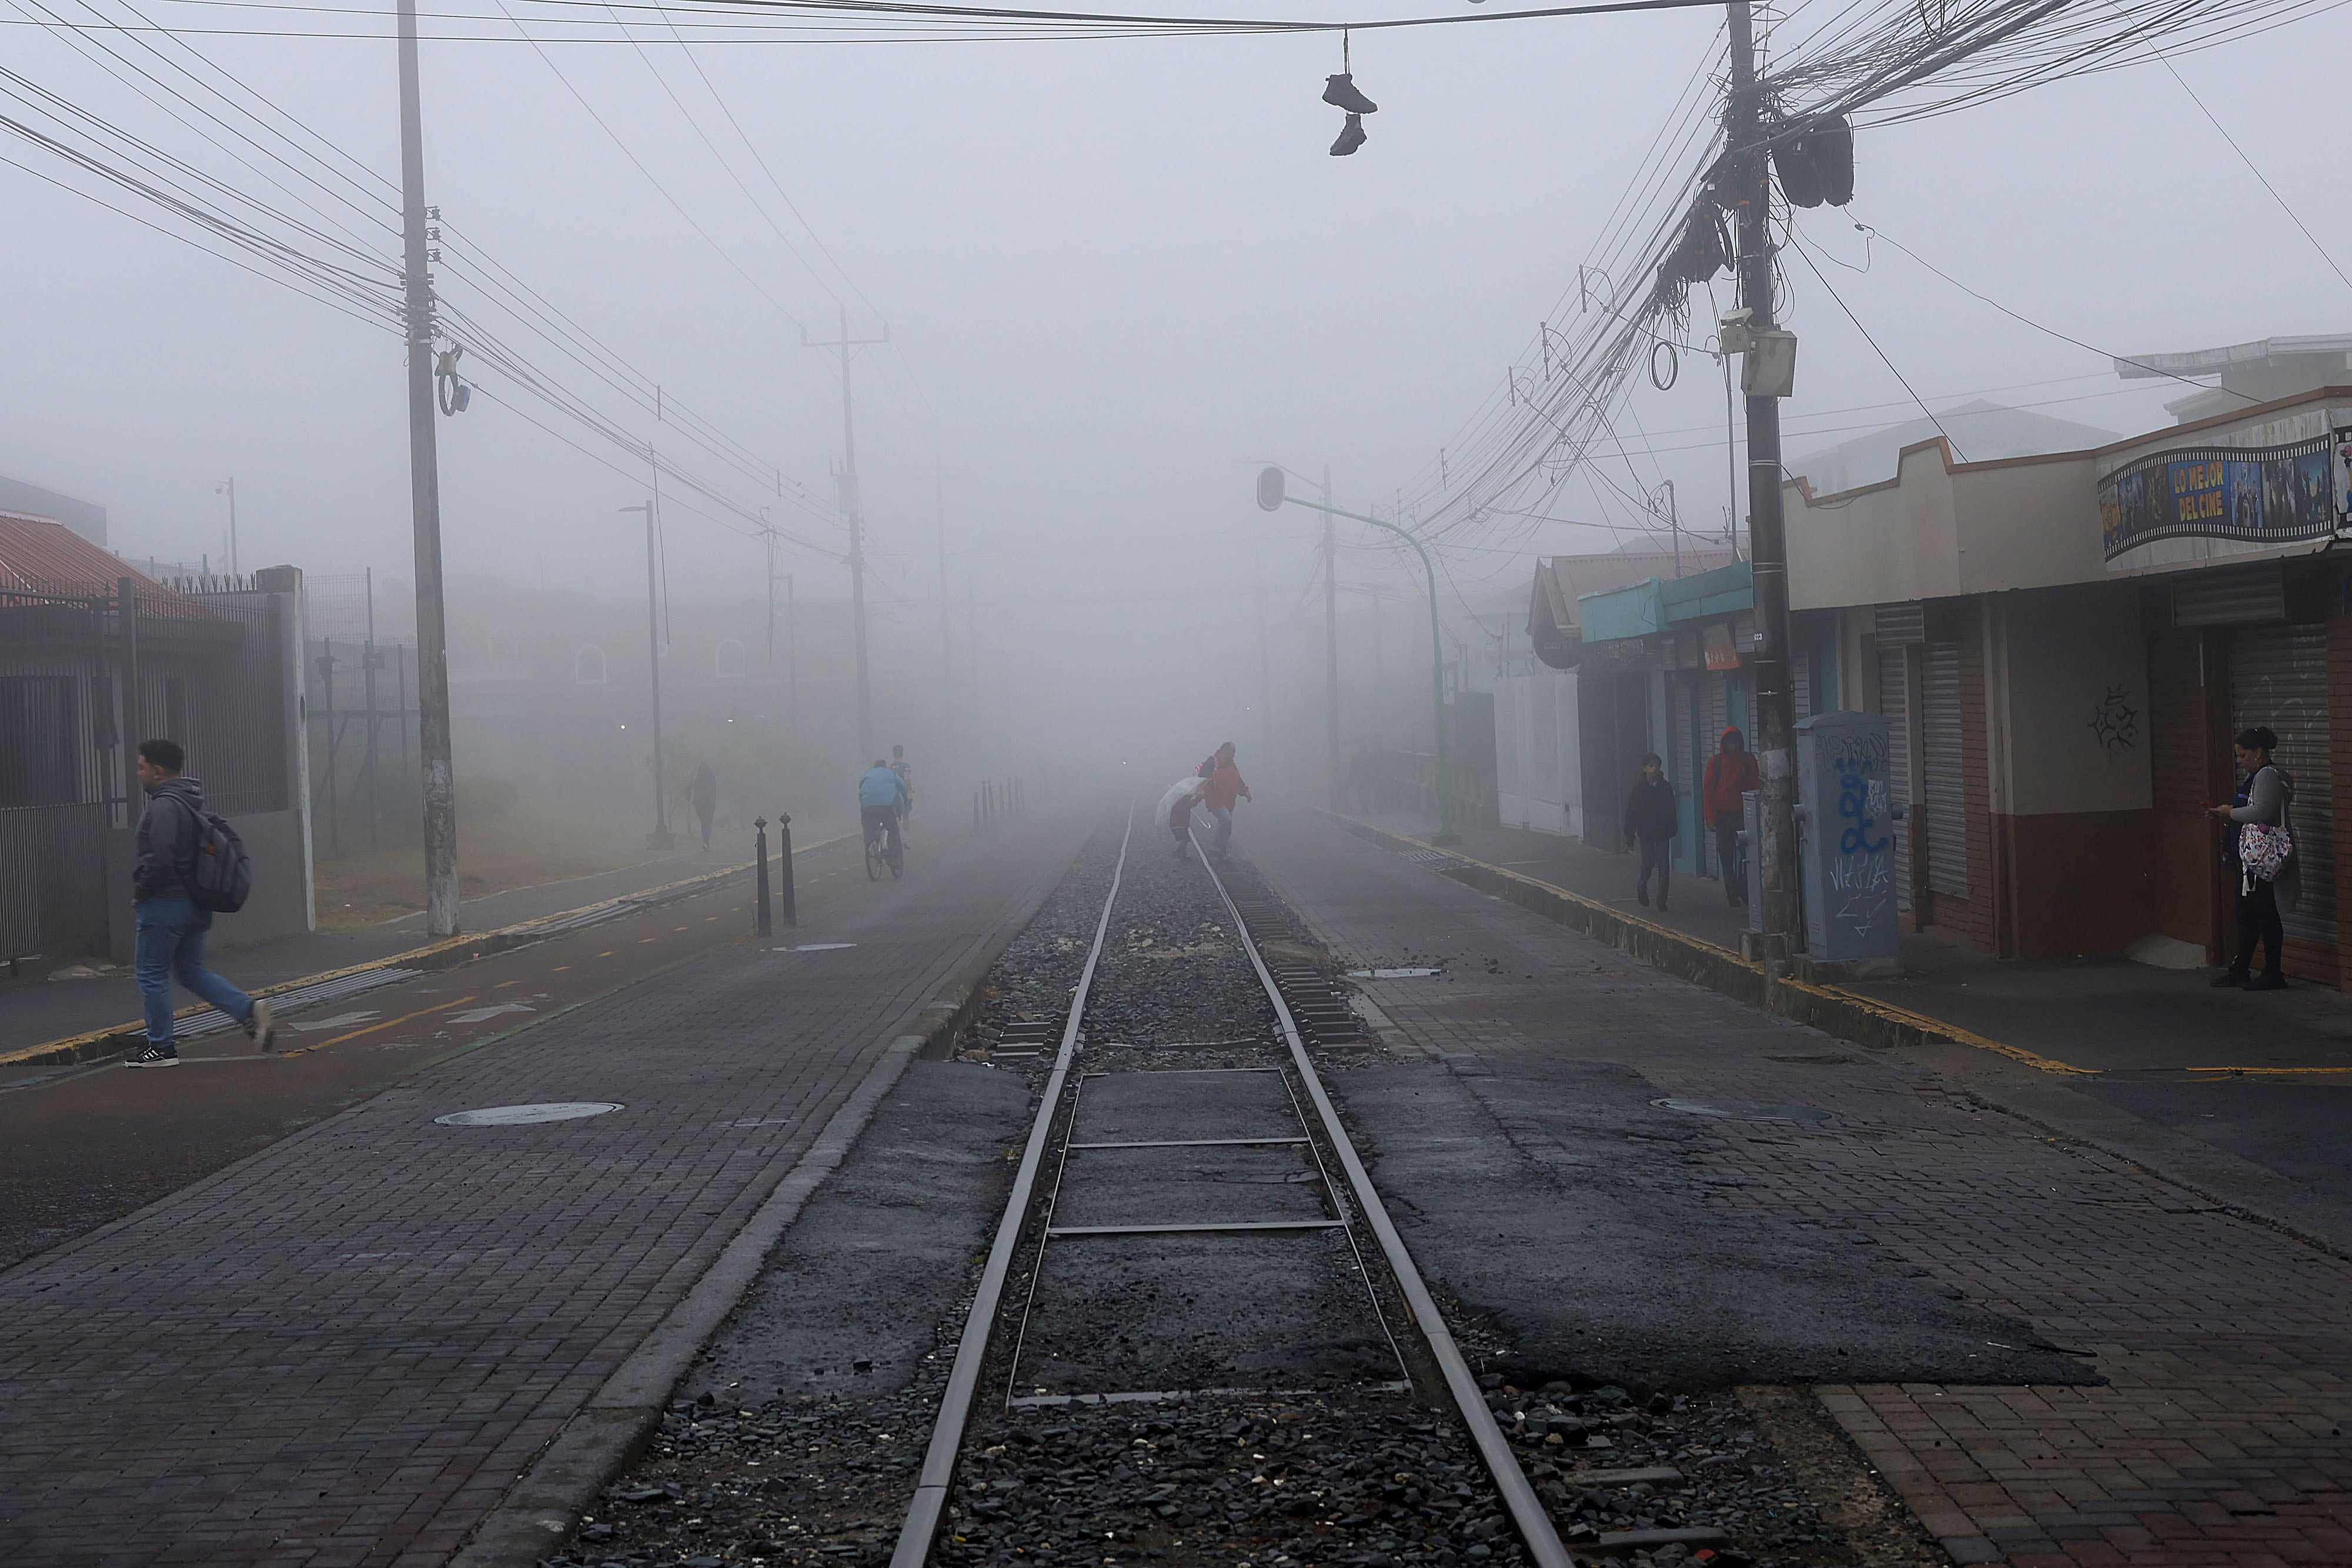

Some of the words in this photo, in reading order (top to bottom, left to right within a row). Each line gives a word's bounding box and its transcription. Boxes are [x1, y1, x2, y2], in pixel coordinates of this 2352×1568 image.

[2174, 468, 2186, 494] LO
[2189, 461, 2224, 491] MEJOR
[2179, 496, 2199, 522] DEL
[2199, 490, 2223, 518] CINE
